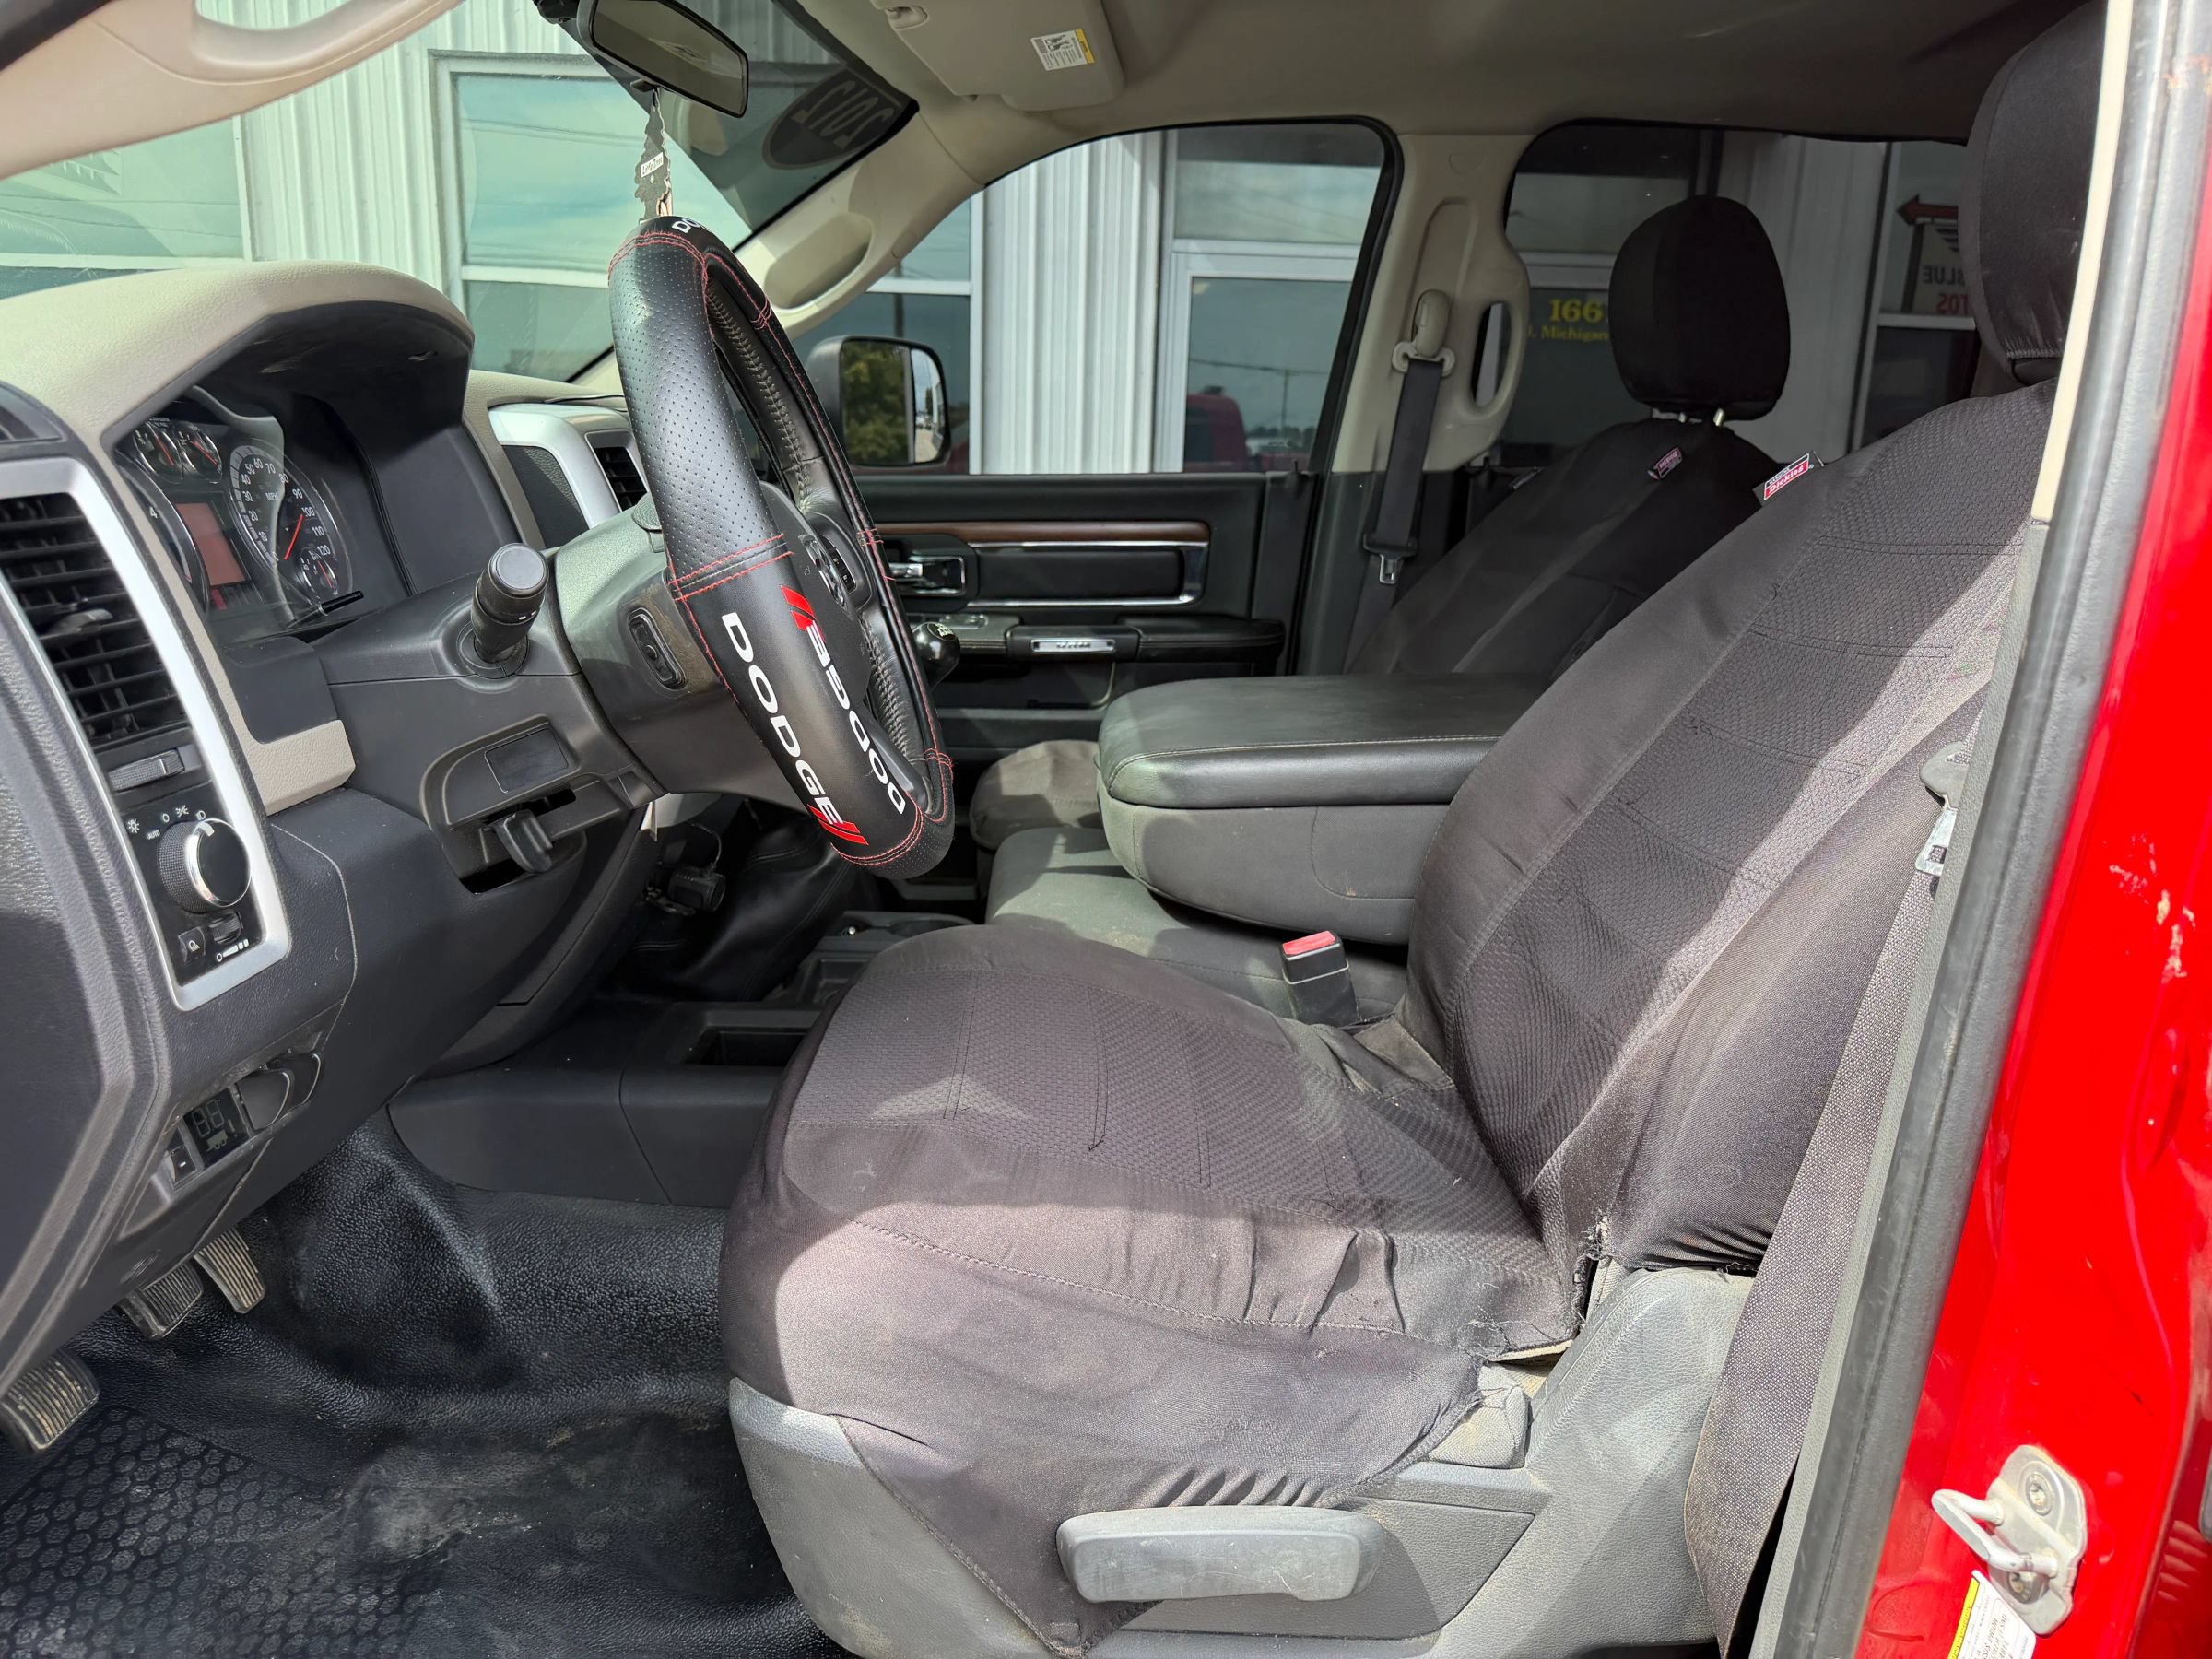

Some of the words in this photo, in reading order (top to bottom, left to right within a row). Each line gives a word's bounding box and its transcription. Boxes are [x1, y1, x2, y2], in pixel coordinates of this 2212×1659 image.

[1540, 324, 1608, 343] Michigan
[245, 464, 255, 475] 50
[254, 458, 264, 469] 60
[265, 463, 276, 474] 70
[241, 474, 252, 485] 40
[279, 473, 289, 484] 80
[1768, 465, 1804, 495] Dickies
[242, 490, 253, 502] 30
[292, 488, 303, 500] 90
[248, 510, 259, 522] 20
[301, 507, 315, 517] 100
[258, 531, 268, 543] 10
[312, 525, 325, 537] 110
[317, 544, 331, 556] 120
[722, 612, 843, 825] DODGE
[806, 620, 906, 815] DODGE
[146, 830, 160, 840] AUTO
